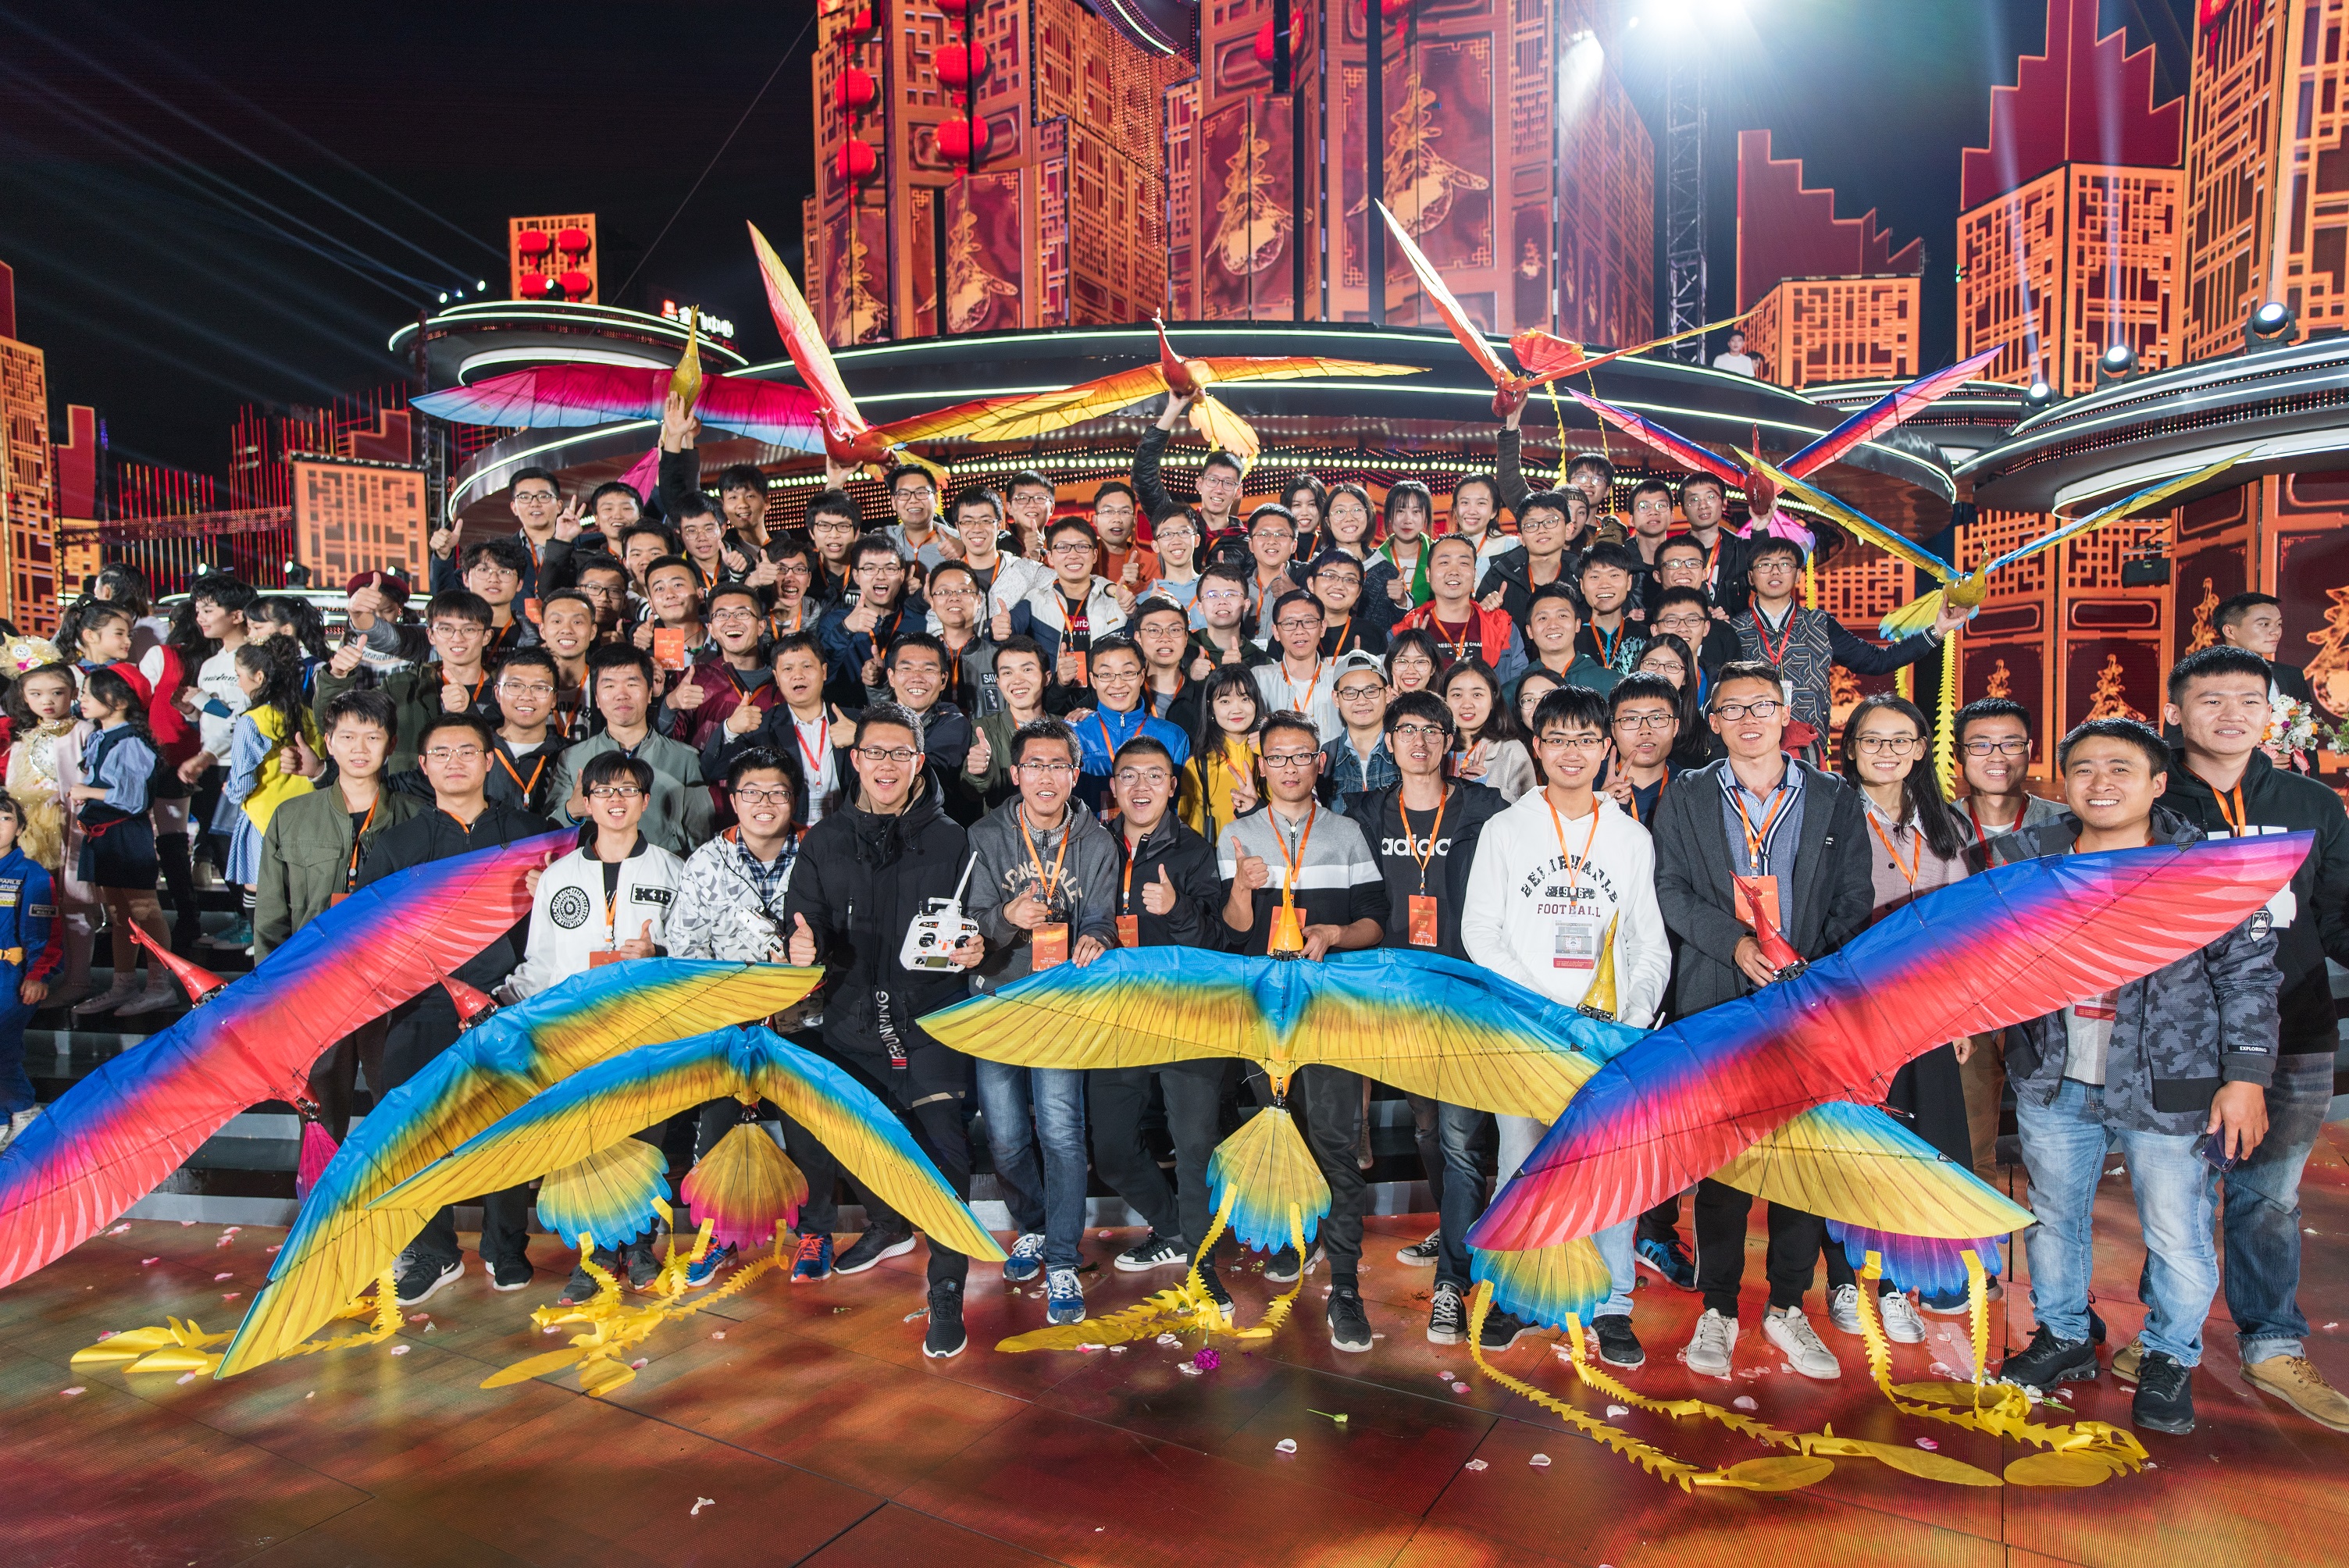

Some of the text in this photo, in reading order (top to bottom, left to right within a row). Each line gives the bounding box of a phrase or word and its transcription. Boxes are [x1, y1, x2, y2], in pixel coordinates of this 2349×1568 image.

[1001, 860, 1083, 904] LONSDALE
[1556, 887, 1584, 898] 196
[1537, 903, 1601, 918] FOOTBALL
